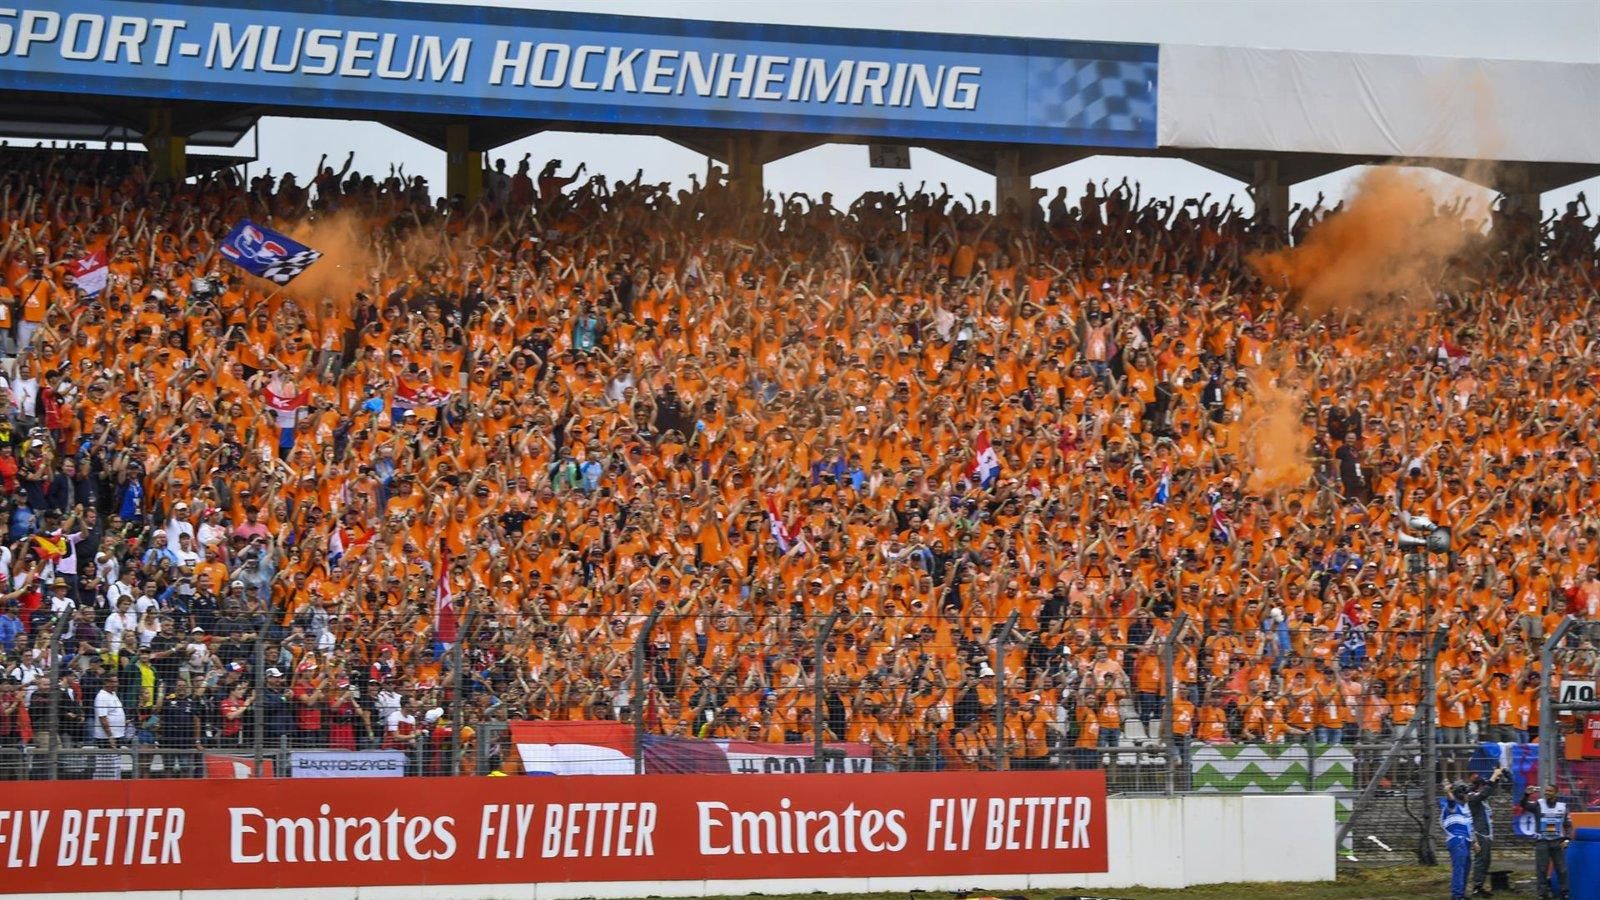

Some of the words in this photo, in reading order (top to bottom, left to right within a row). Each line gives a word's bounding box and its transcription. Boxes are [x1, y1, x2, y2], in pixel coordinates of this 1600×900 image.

[490, 40, 983, 111] HOCKENHEIMRING
[299, 759, 397, 771] BARTOSZYCE
[0, 810, 50, 868] FLY
[57, 807, 186, 867] BETTER
[228, 803, 457, 867] Emirates
[478, 804, 535, 860] FLY
[541, 802, 657, 858] BETTER
[697, 797, 908, 856] Emirates
[927, 798, 977, 853] FLY
[985, 796, 1092, 851] BETTER
